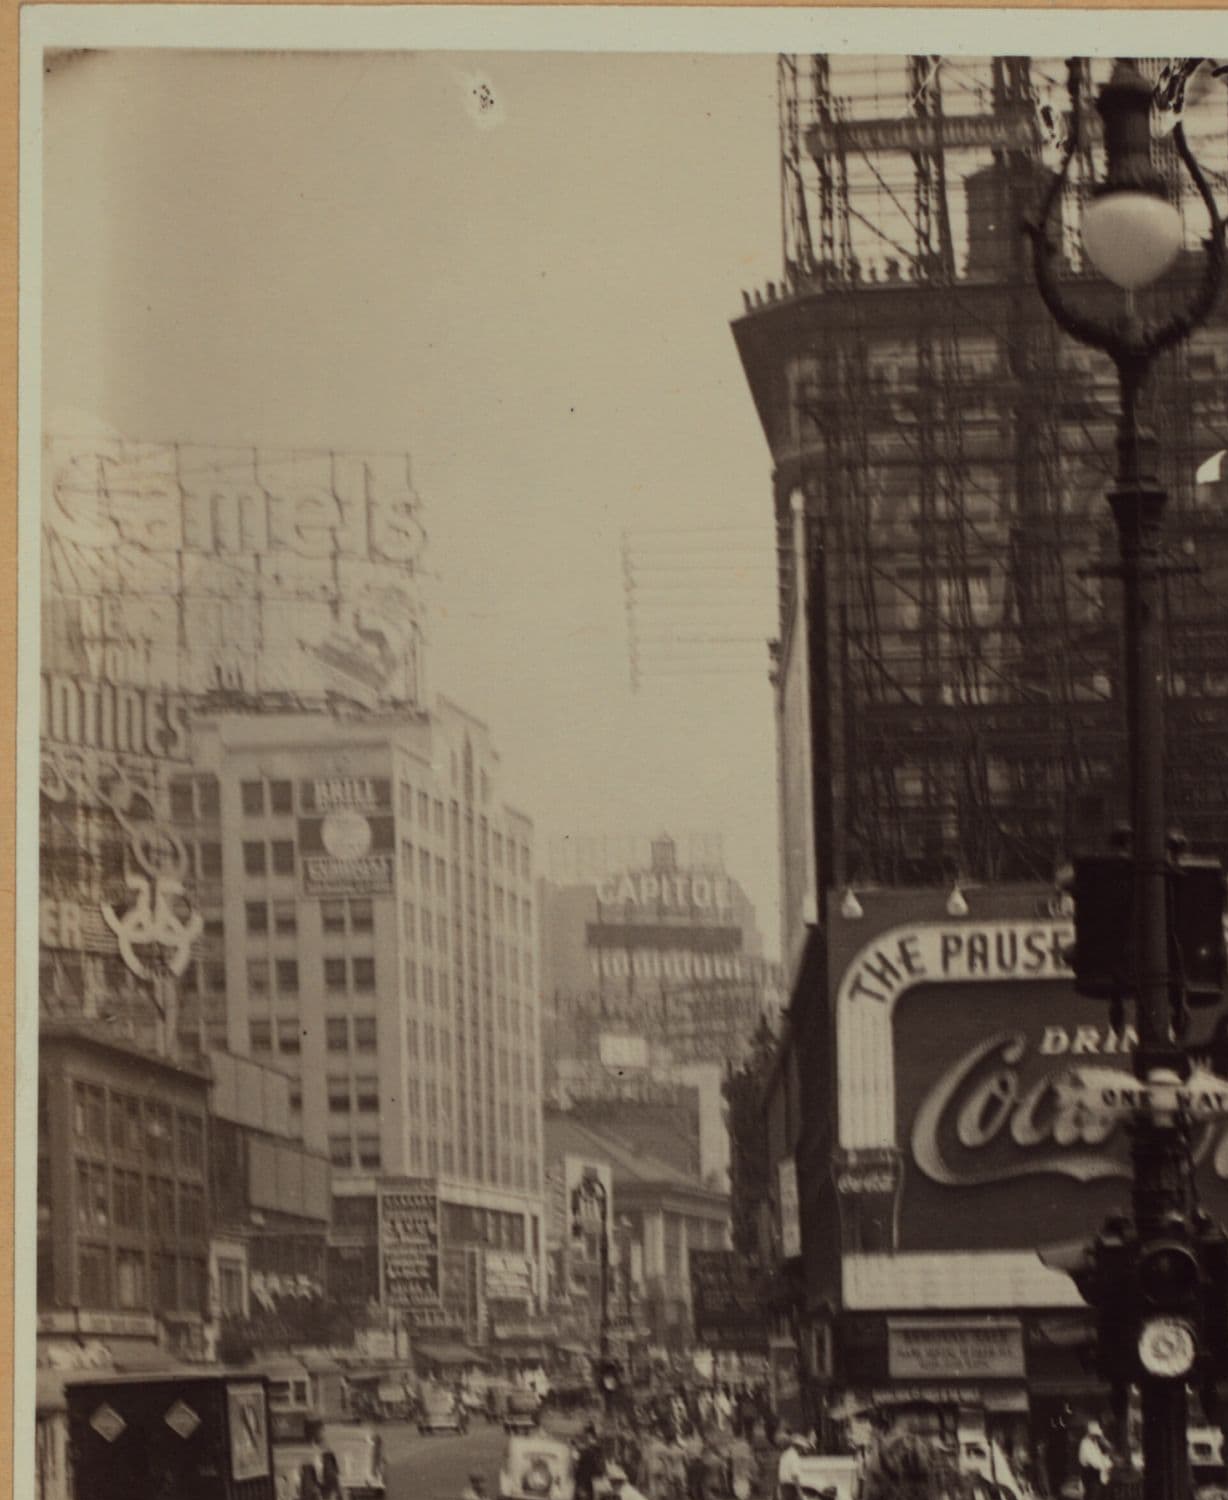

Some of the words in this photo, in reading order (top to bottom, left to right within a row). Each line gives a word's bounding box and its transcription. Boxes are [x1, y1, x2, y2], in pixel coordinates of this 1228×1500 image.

[595, 870, 731, 913] CAPITOL
[848, 934, 927, 1003] THE
[940, 929, 1076, 976] PAUSE
[1040, 1024, 1176, 1056] DRIN
[1100, 1088, 1150, 1108] ONE
